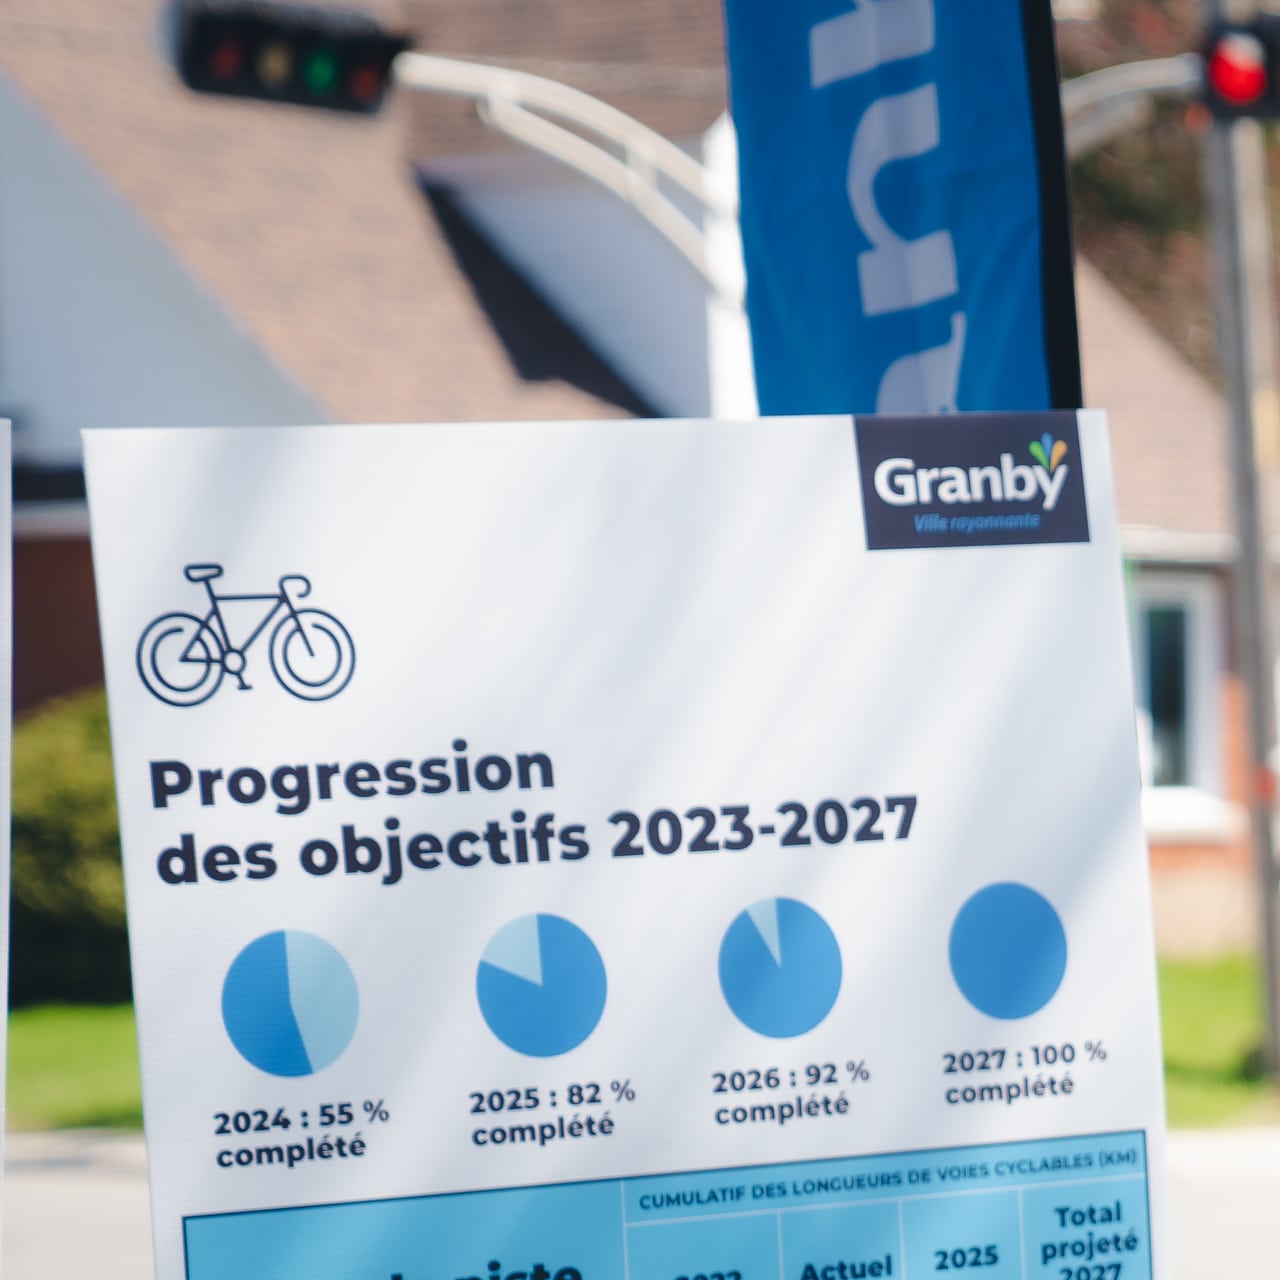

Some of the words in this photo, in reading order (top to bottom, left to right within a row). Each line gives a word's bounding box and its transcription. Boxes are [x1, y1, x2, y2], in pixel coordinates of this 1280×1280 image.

[874, 453, 1069, 510] Granby
[914, 513, 948, 532] Ville
[149, 738, 555, 816] Progression
[157, 834, 277, 885] des
[300, 810, 590, 886] objectifs
[608, 795, 919, 858] 2023-2027
[942, 1048, 1006, 1074] 2027
[1032, 1043, 1077, 1066] 100
[1085, 1040, 1107, 1062] %
[712, 1067, 781, 1095] 2026
[805, 1063, 839, 1086] 92
[846, 1060, 870, 1082] %
[945, 1072, 1075, 1106] complété
[469, 1088, 541, 1114] 2025
[567, 1082, 602, 1106] 82
[611, 1079, 636, 1102] %
[714, 1090, 850, 1125] complété
[214, 1108, 291, 1135] 2024
[319, 1103, 354, 1127] 55
[363, 1099, 390, 1123] %
[472, 1110, 616, 1147] complété
[216, 1130, 367, 1168] complété
[639, 1185, 746, 1210] CUMULATIF
[751, 1181, 788, 1200] DES
[793, 1171, 902, 1195] LONGUEURS
[907, 1168, 932, 1185] DE
[936, 1162, 990, 1182] VOIES
[995, 1153, 1095, 1177] CYCLABLES
[1098, 1147, 1137, 1169] (KM)
[1054, 1199, 1122, 1228] Total
[934, 1244, 999, 1271] 2025
[1041, 1232, 1139, 1265] projeté
